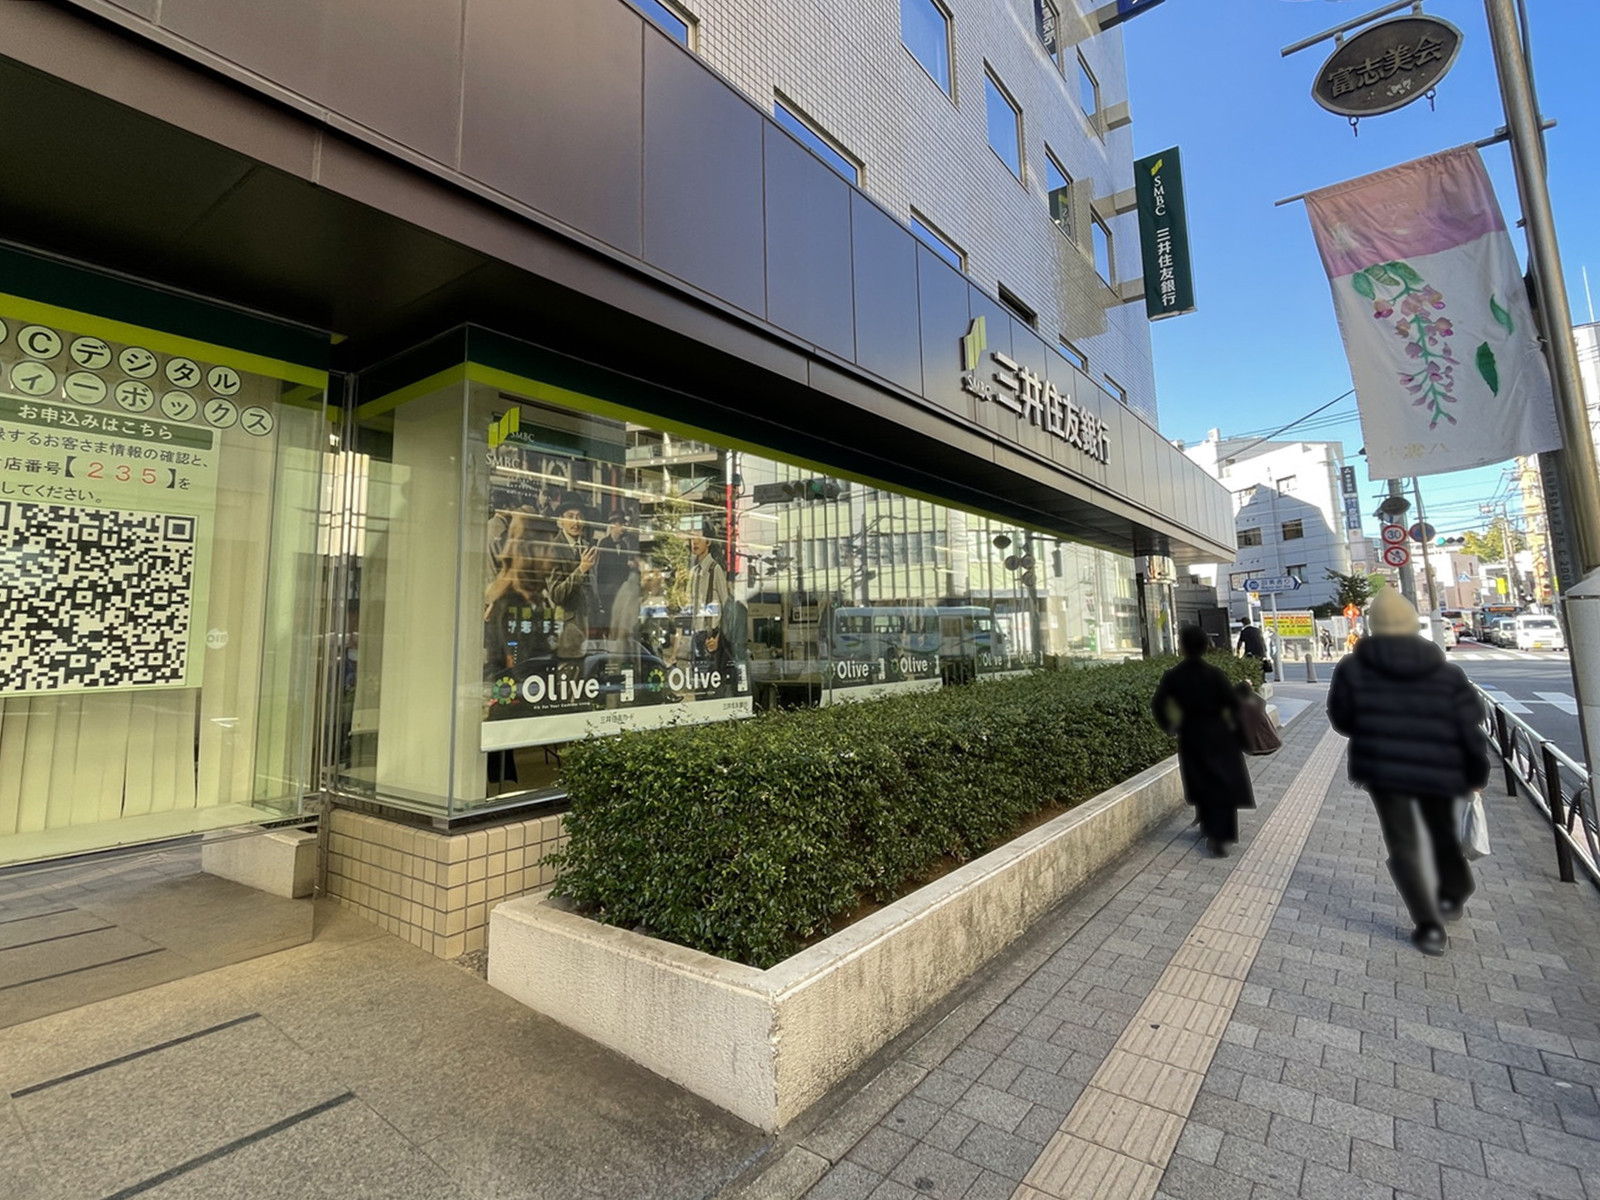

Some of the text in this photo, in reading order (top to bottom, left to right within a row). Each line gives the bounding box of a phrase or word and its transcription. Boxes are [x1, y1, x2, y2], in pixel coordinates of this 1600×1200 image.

[1328, 35, 1445, 99] 富志美会
[1153, 175, 1167, 216] SMBC
[1156, 227, 1177, 307] 三井住友銀行
[995, 351, 1112, 466] 三井住友銀行
[17, 403, 173, 440] お申込みはこちら
[485, 452, 521, 470] SMBC
[1, 481, 102, 503] してください。
[1386, 530, 1402, 541] 30
[837, 659, 870, 679] Olive
[900, 656, 929, 673] Olive
[982, 652, 1003, 667] Olve
[521, 673, 600, 703] Olive
[668, 666, 722, 691] Olive
